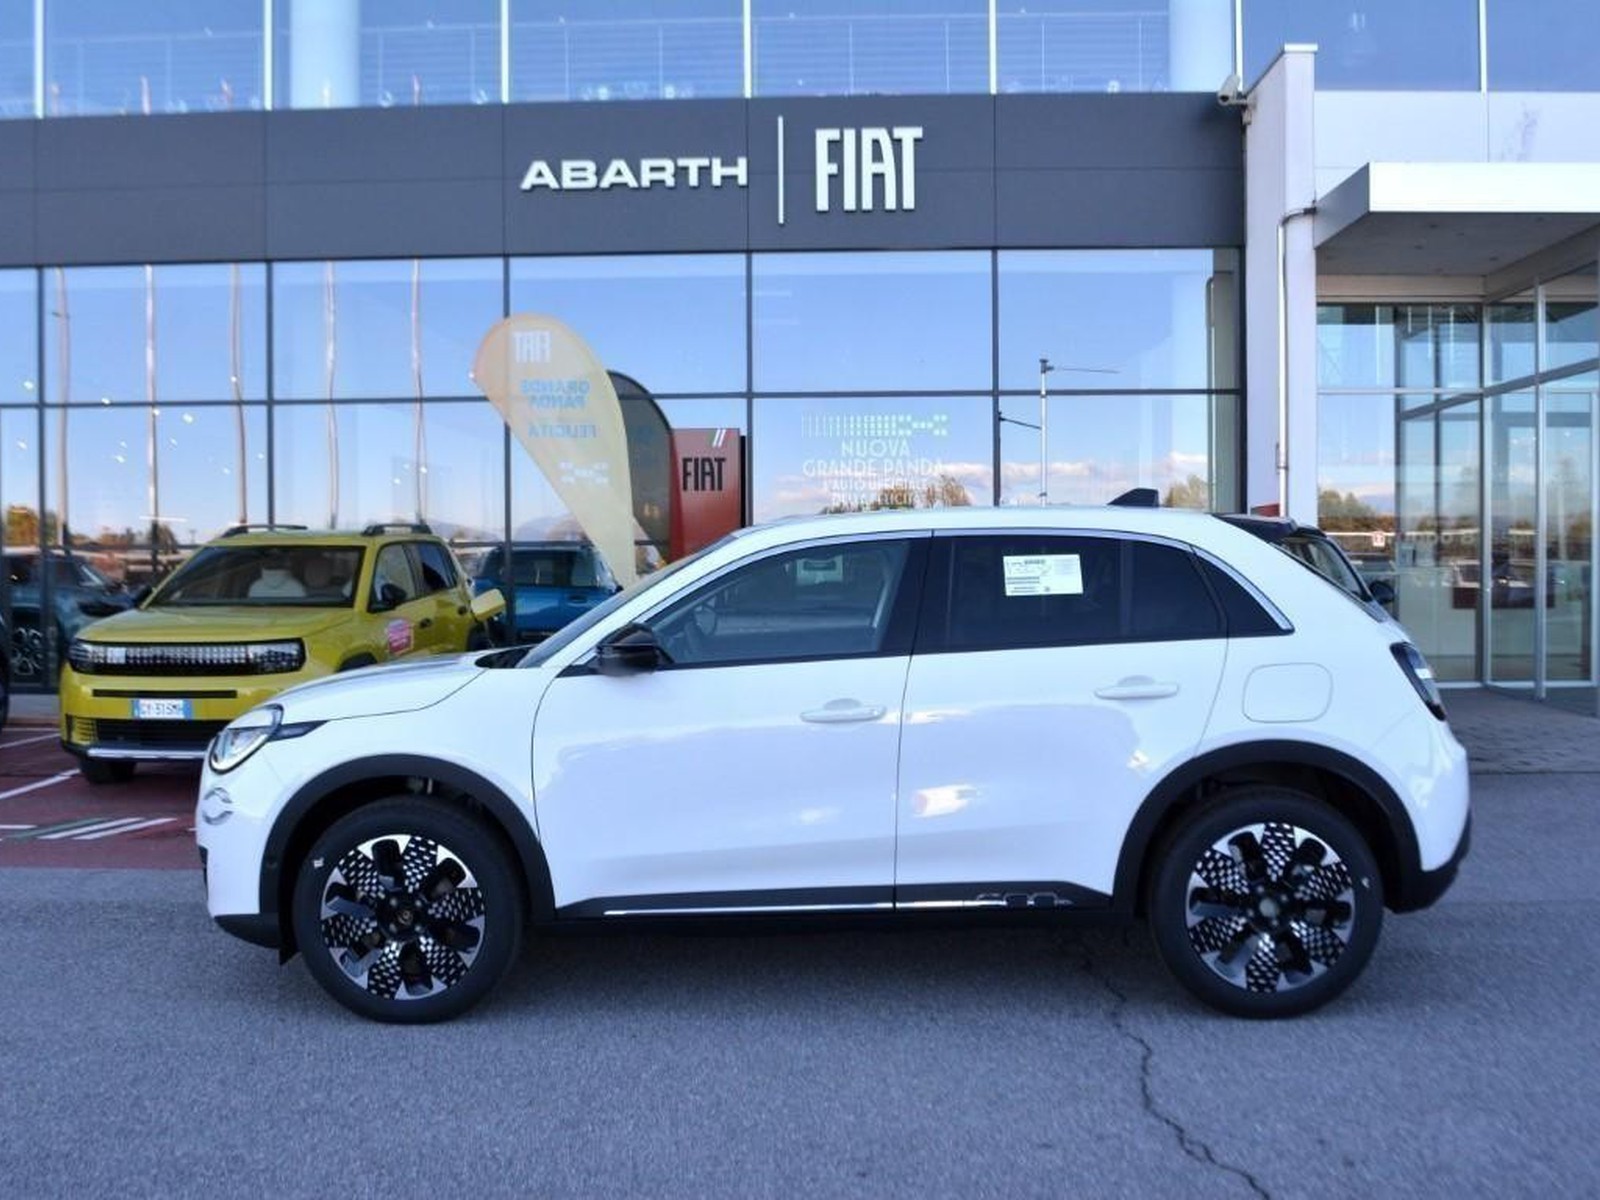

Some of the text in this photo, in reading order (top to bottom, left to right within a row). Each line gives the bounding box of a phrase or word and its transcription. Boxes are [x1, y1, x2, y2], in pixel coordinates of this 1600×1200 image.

[520, 157, 748, 190] ABARTH
[815, 126, 924, 212] FIAT
[841, 438, 911, 457] NUOVA
[682, 457, 726, 491] FIAT
[803, 458, 944, 477] GRANDE PANDA
